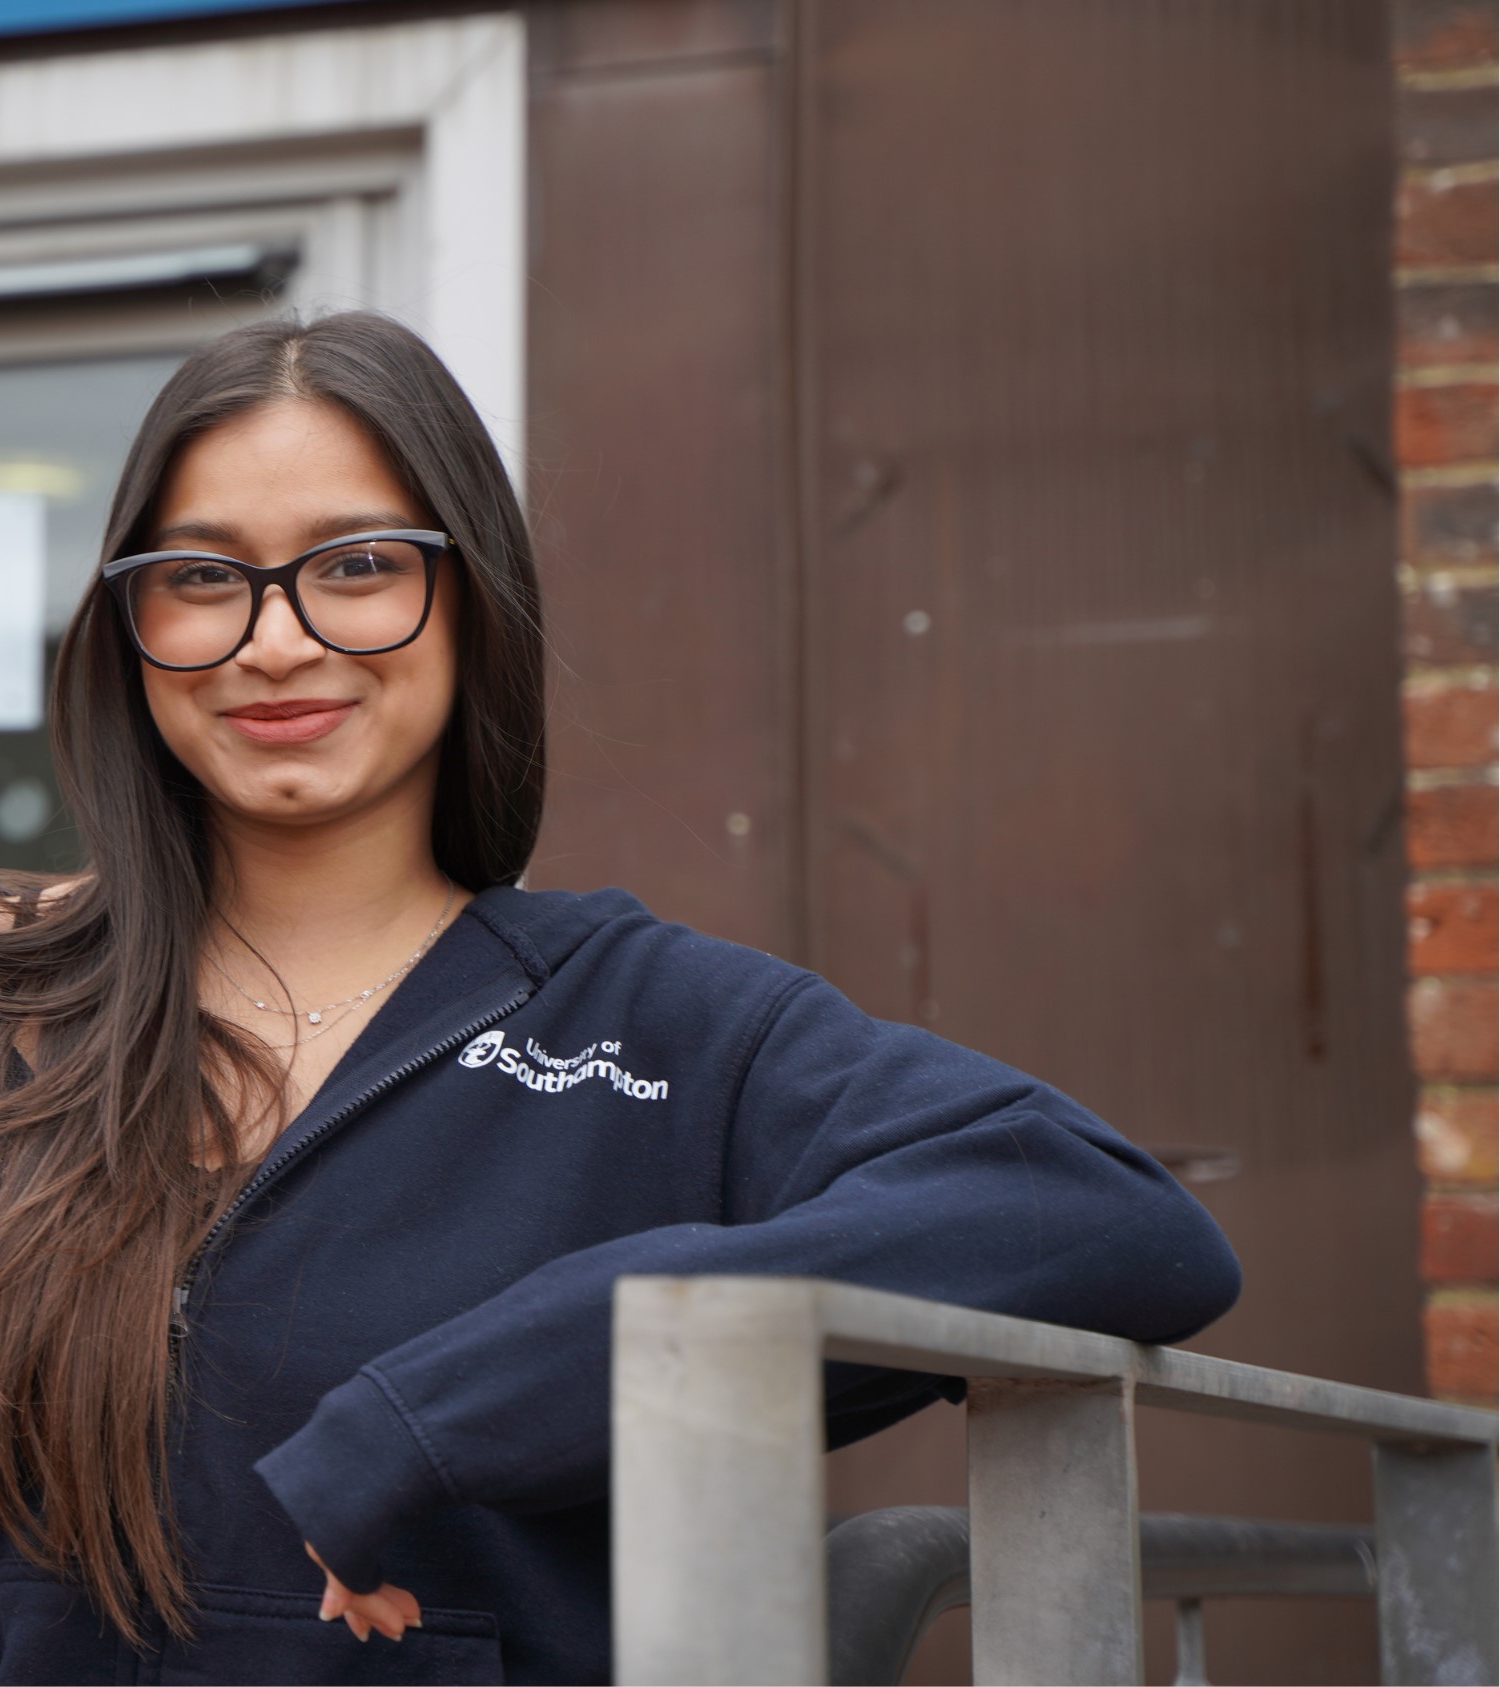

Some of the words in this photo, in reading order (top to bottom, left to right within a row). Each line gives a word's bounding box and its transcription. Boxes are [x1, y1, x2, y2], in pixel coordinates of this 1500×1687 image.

[496, 1047, 670, 1101] Southampton
[525, 1037, 598, 1071] University
[600, 1040, 623, 1056] of
